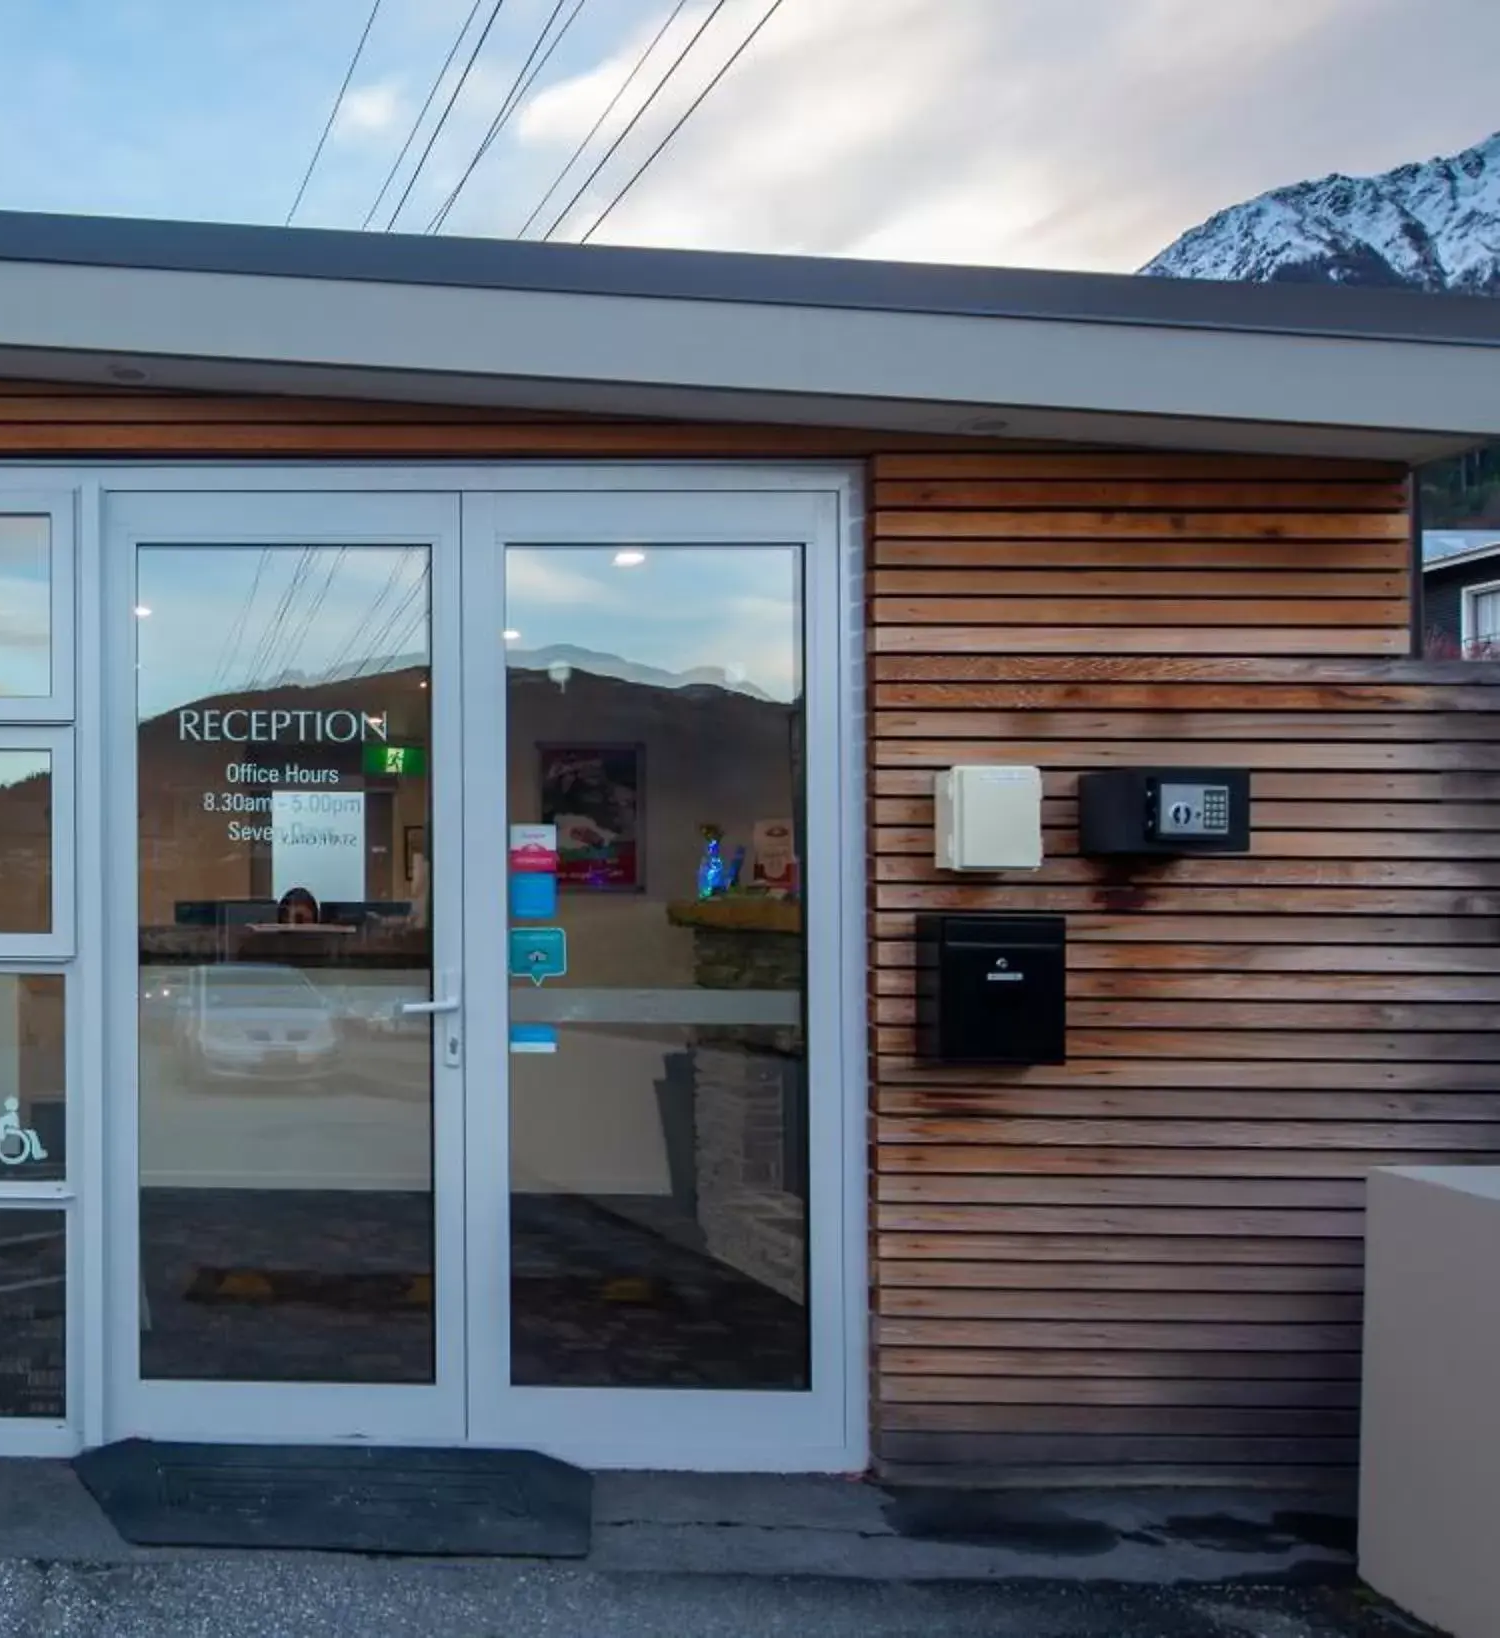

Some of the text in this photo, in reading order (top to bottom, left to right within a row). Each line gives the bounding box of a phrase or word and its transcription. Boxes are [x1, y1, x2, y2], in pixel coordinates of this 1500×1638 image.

[179, 709, 388, 742] RECEPTION
[226, 763, 339, 784] Office Hours
[203, 792, 273, 812] 8.30am
[290, 794, 361, 818] 5.00pm
